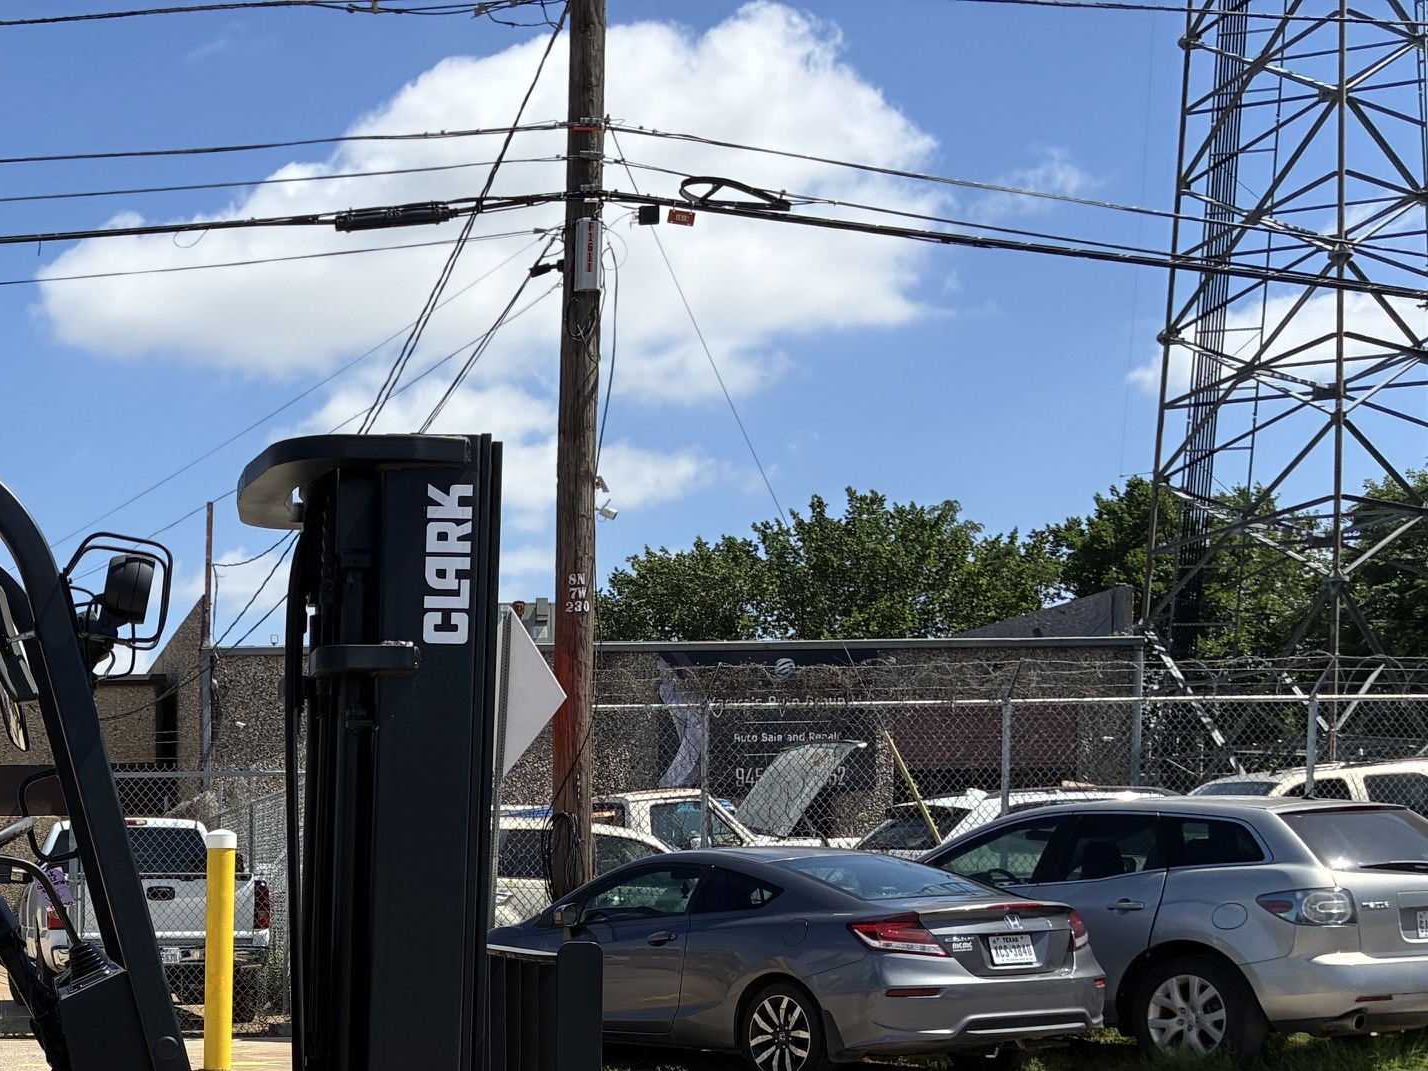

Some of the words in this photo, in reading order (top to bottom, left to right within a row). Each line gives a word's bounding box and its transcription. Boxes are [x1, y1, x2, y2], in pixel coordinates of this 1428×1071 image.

[422, 483, 474, 645] CLARK
[569, 586, 588, 599] 7W
[565, 600, 590, 613] 230
[734, 733, 758, 742] Auto
[761, 732, 783, 742] Sale
[787, 732, 805, 742] and
